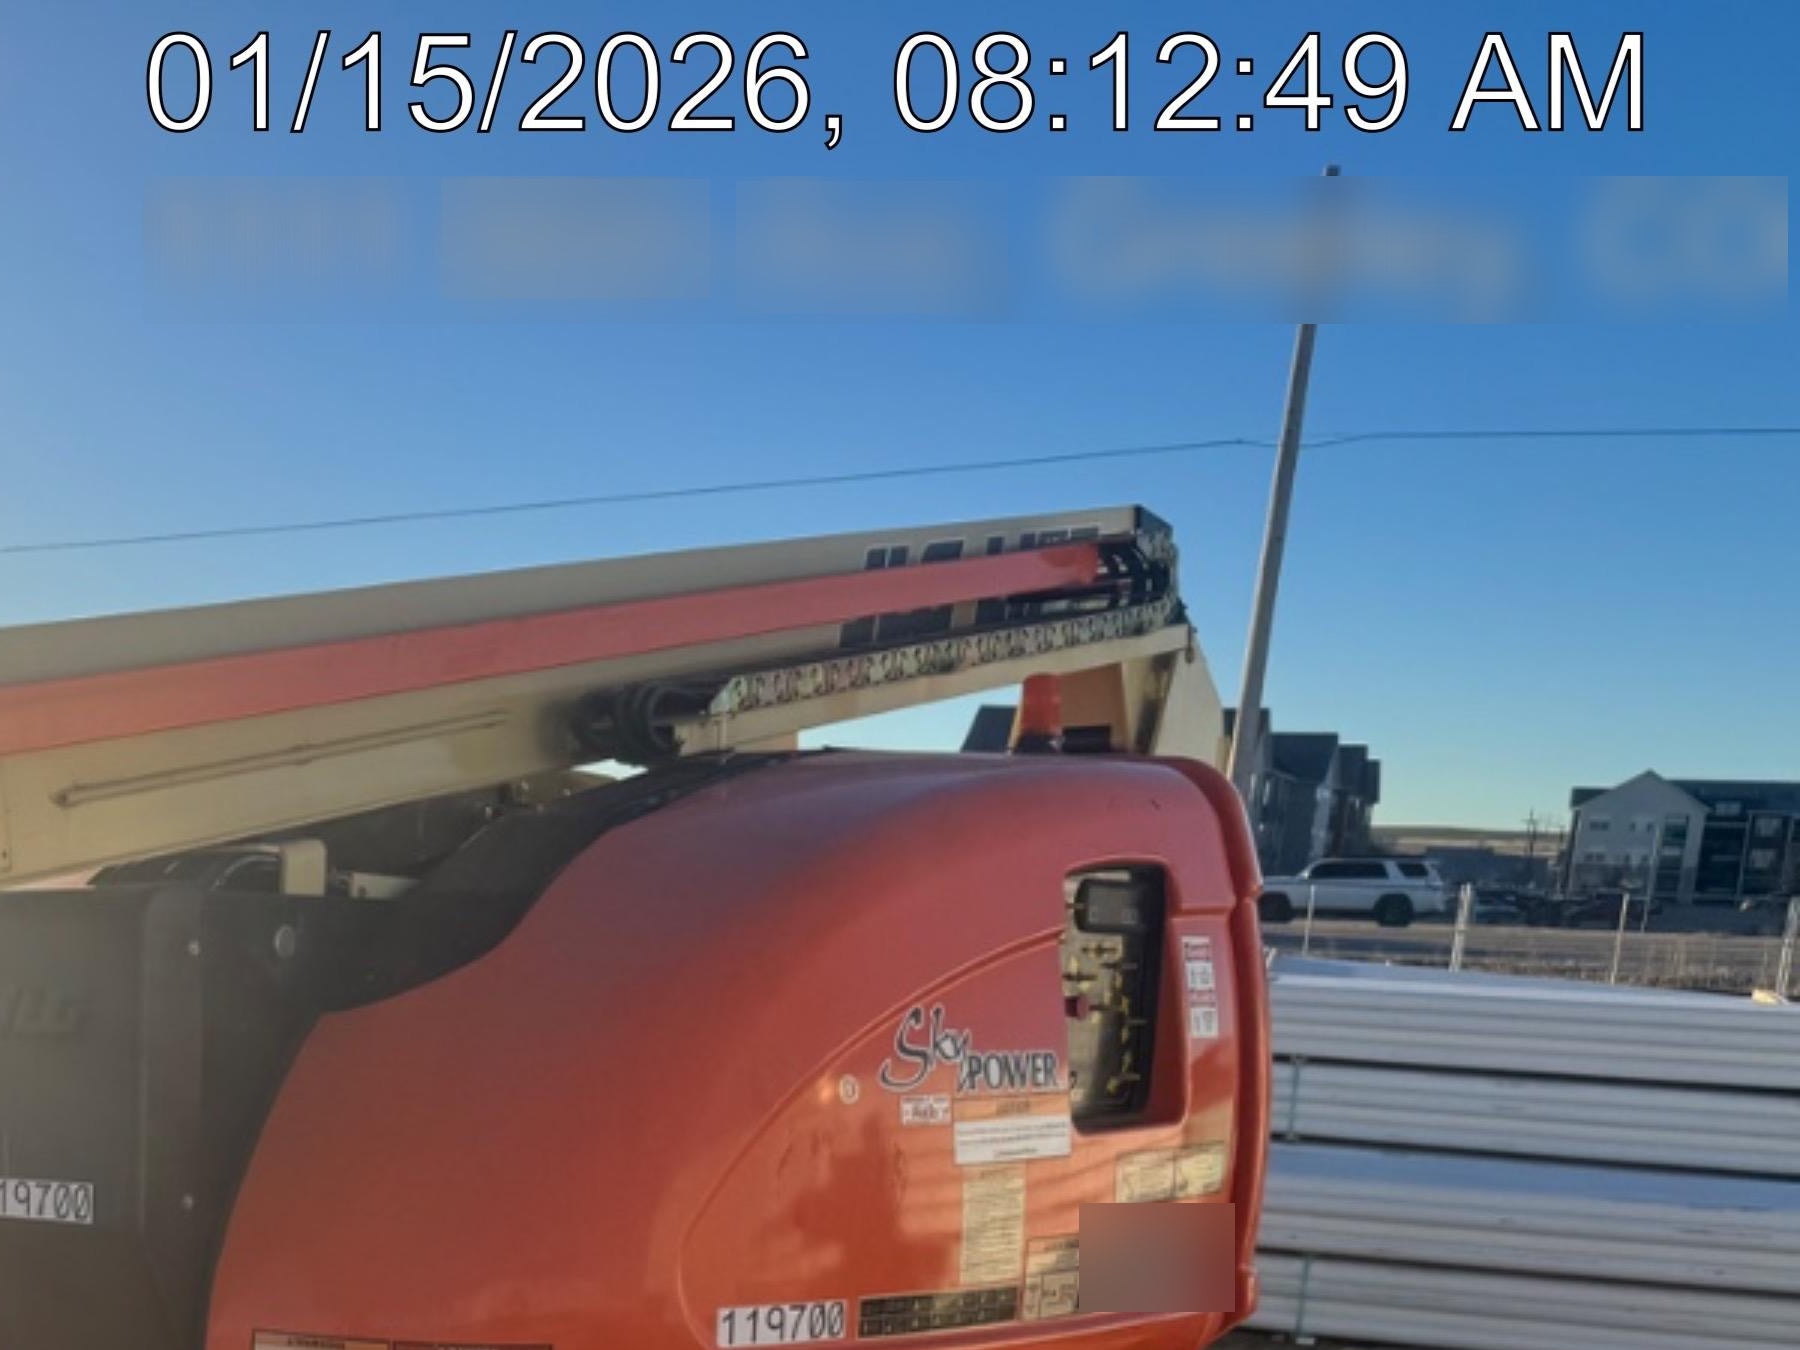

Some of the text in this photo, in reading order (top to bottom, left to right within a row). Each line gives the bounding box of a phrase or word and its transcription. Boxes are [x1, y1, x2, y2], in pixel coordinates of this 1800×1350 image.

[880, 1004, 1059, 1092] Sky POWER
[721, 1301, 845, 1346] 119700
